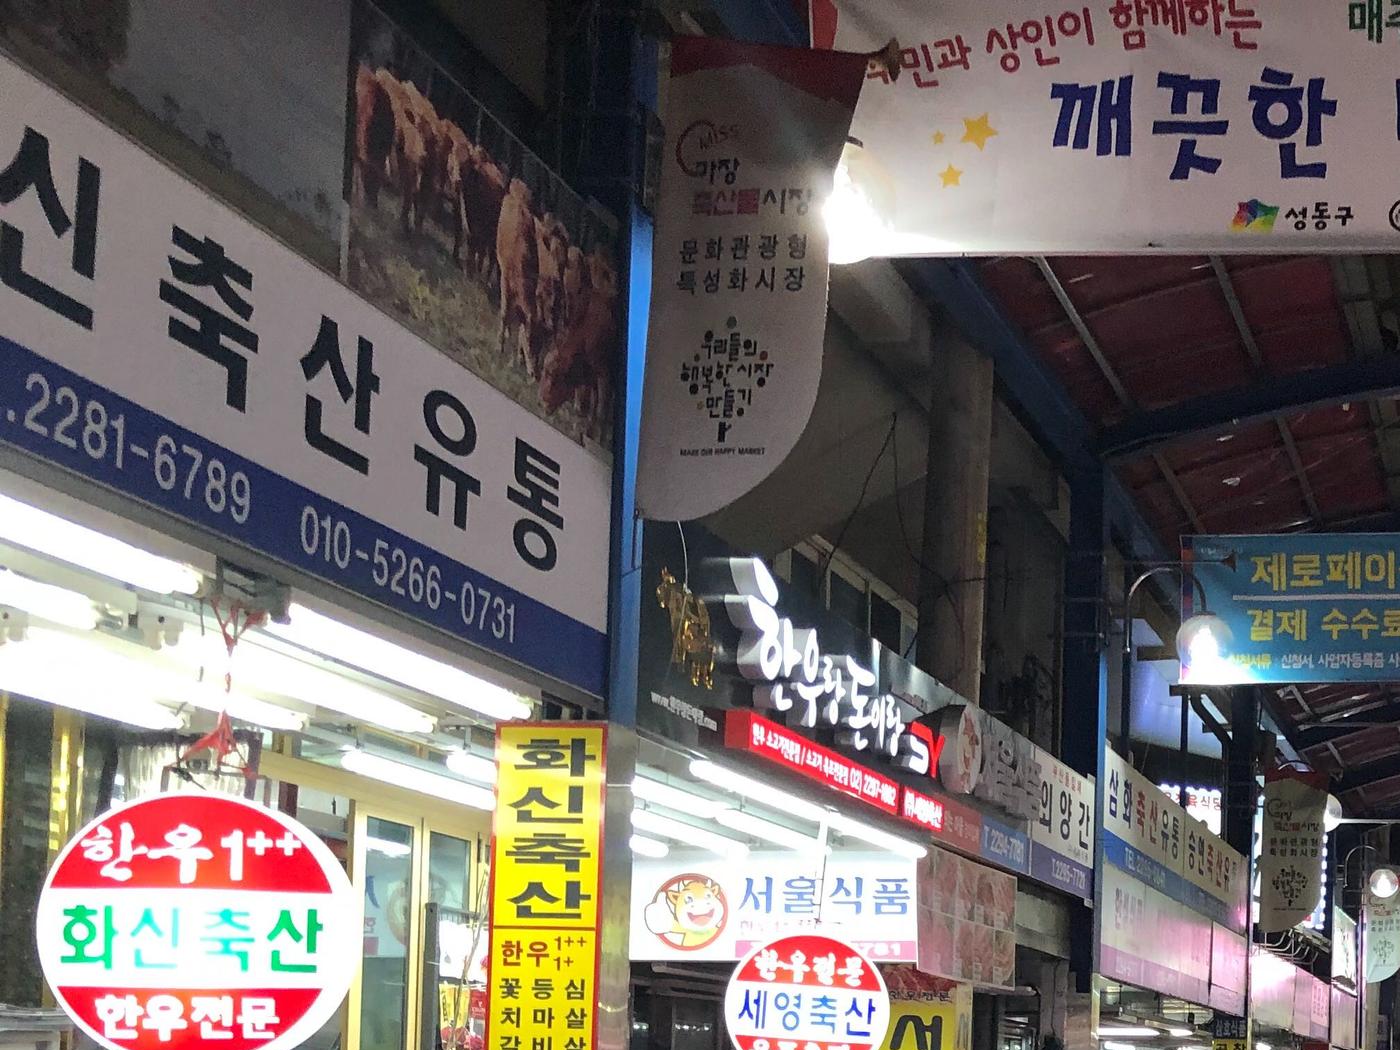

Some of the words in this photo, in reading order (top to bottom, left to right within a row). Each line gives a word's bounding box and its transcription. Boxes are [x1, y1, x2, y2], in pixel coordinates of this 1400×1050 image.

[986, 7, 1094, 73] 상인이
[1110, 0, 1262, 51] 함께하는
[1050, 67, 1338, 180] 깨끗한
[1284, 201, 1354, 232] 성동구
[300, 505, 517, 645] 010-5266-0731
[1246, 607, 1307, 642] 결제
[506, 737, 597, 919] 화신축산
[738, 875, 911, 916] 서울식품
[60, 904, 324, 973] 화신축산
[501, 940, 550, 969] 한우
[94, 994, 281, 1043] 한우전문
[499, 1006, 587, 1029] 치마살
[737, 989, 876, 1038] 세영축산
